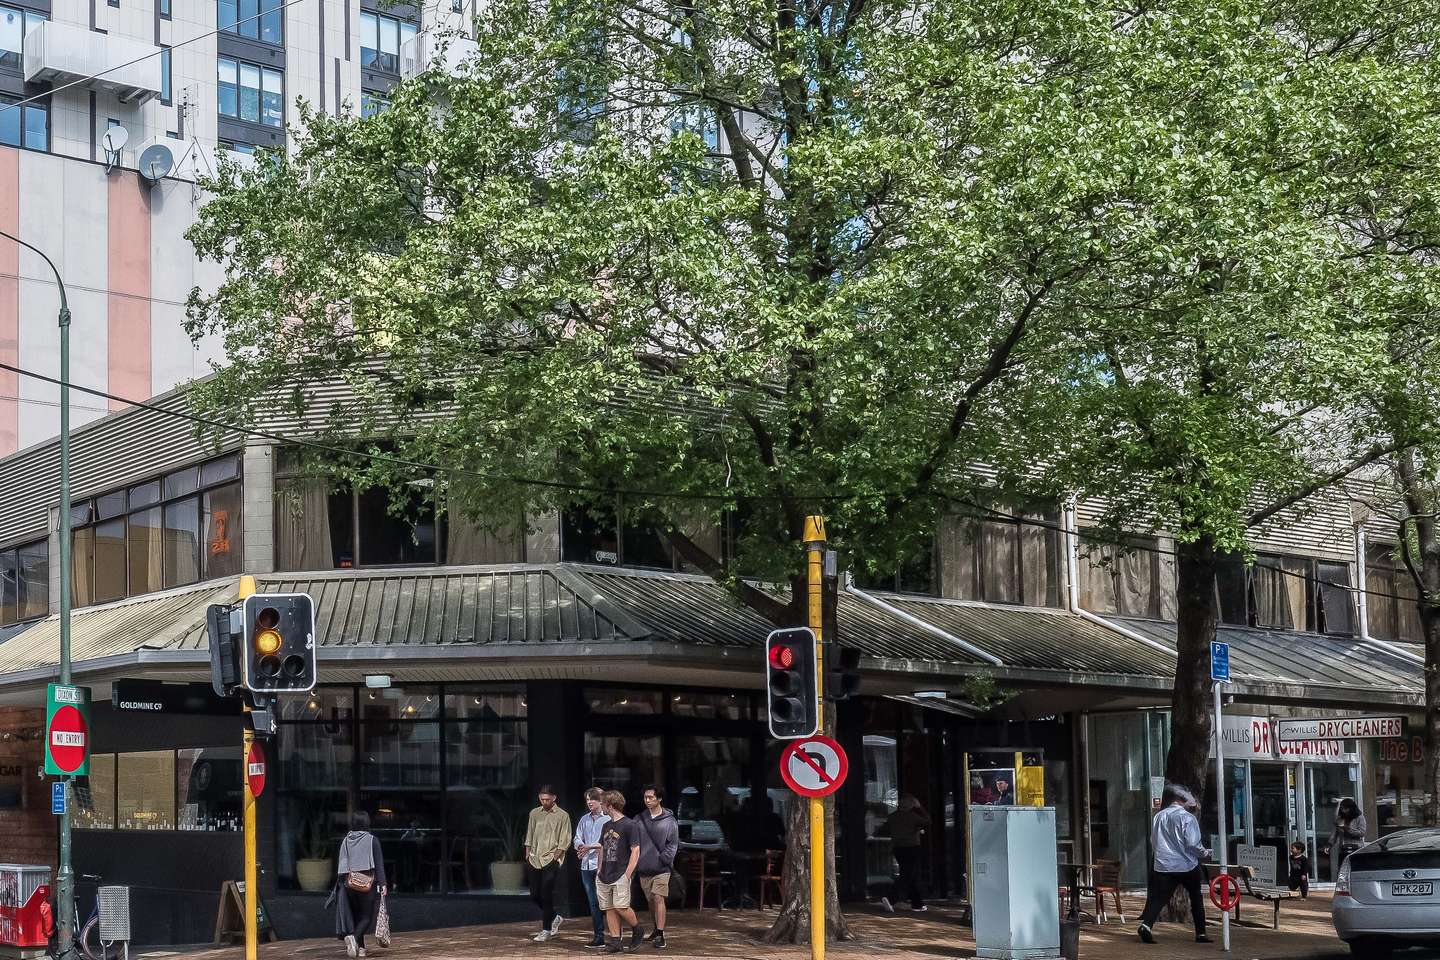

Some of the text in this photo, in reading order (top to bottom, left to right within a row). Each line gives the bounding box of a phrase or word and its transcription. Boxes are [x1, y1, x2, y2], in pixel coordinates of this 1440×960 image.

[120, 701, 154, 710] GOLDMINE
[1289, 719, 1401, 738] WILLIS DRYCLEANERS
[57, 733, 80, 744] NO ENTRY
[1221, 728, 1250, 743] WILLIS
[1393, 884, 1431, 894] MPK207
